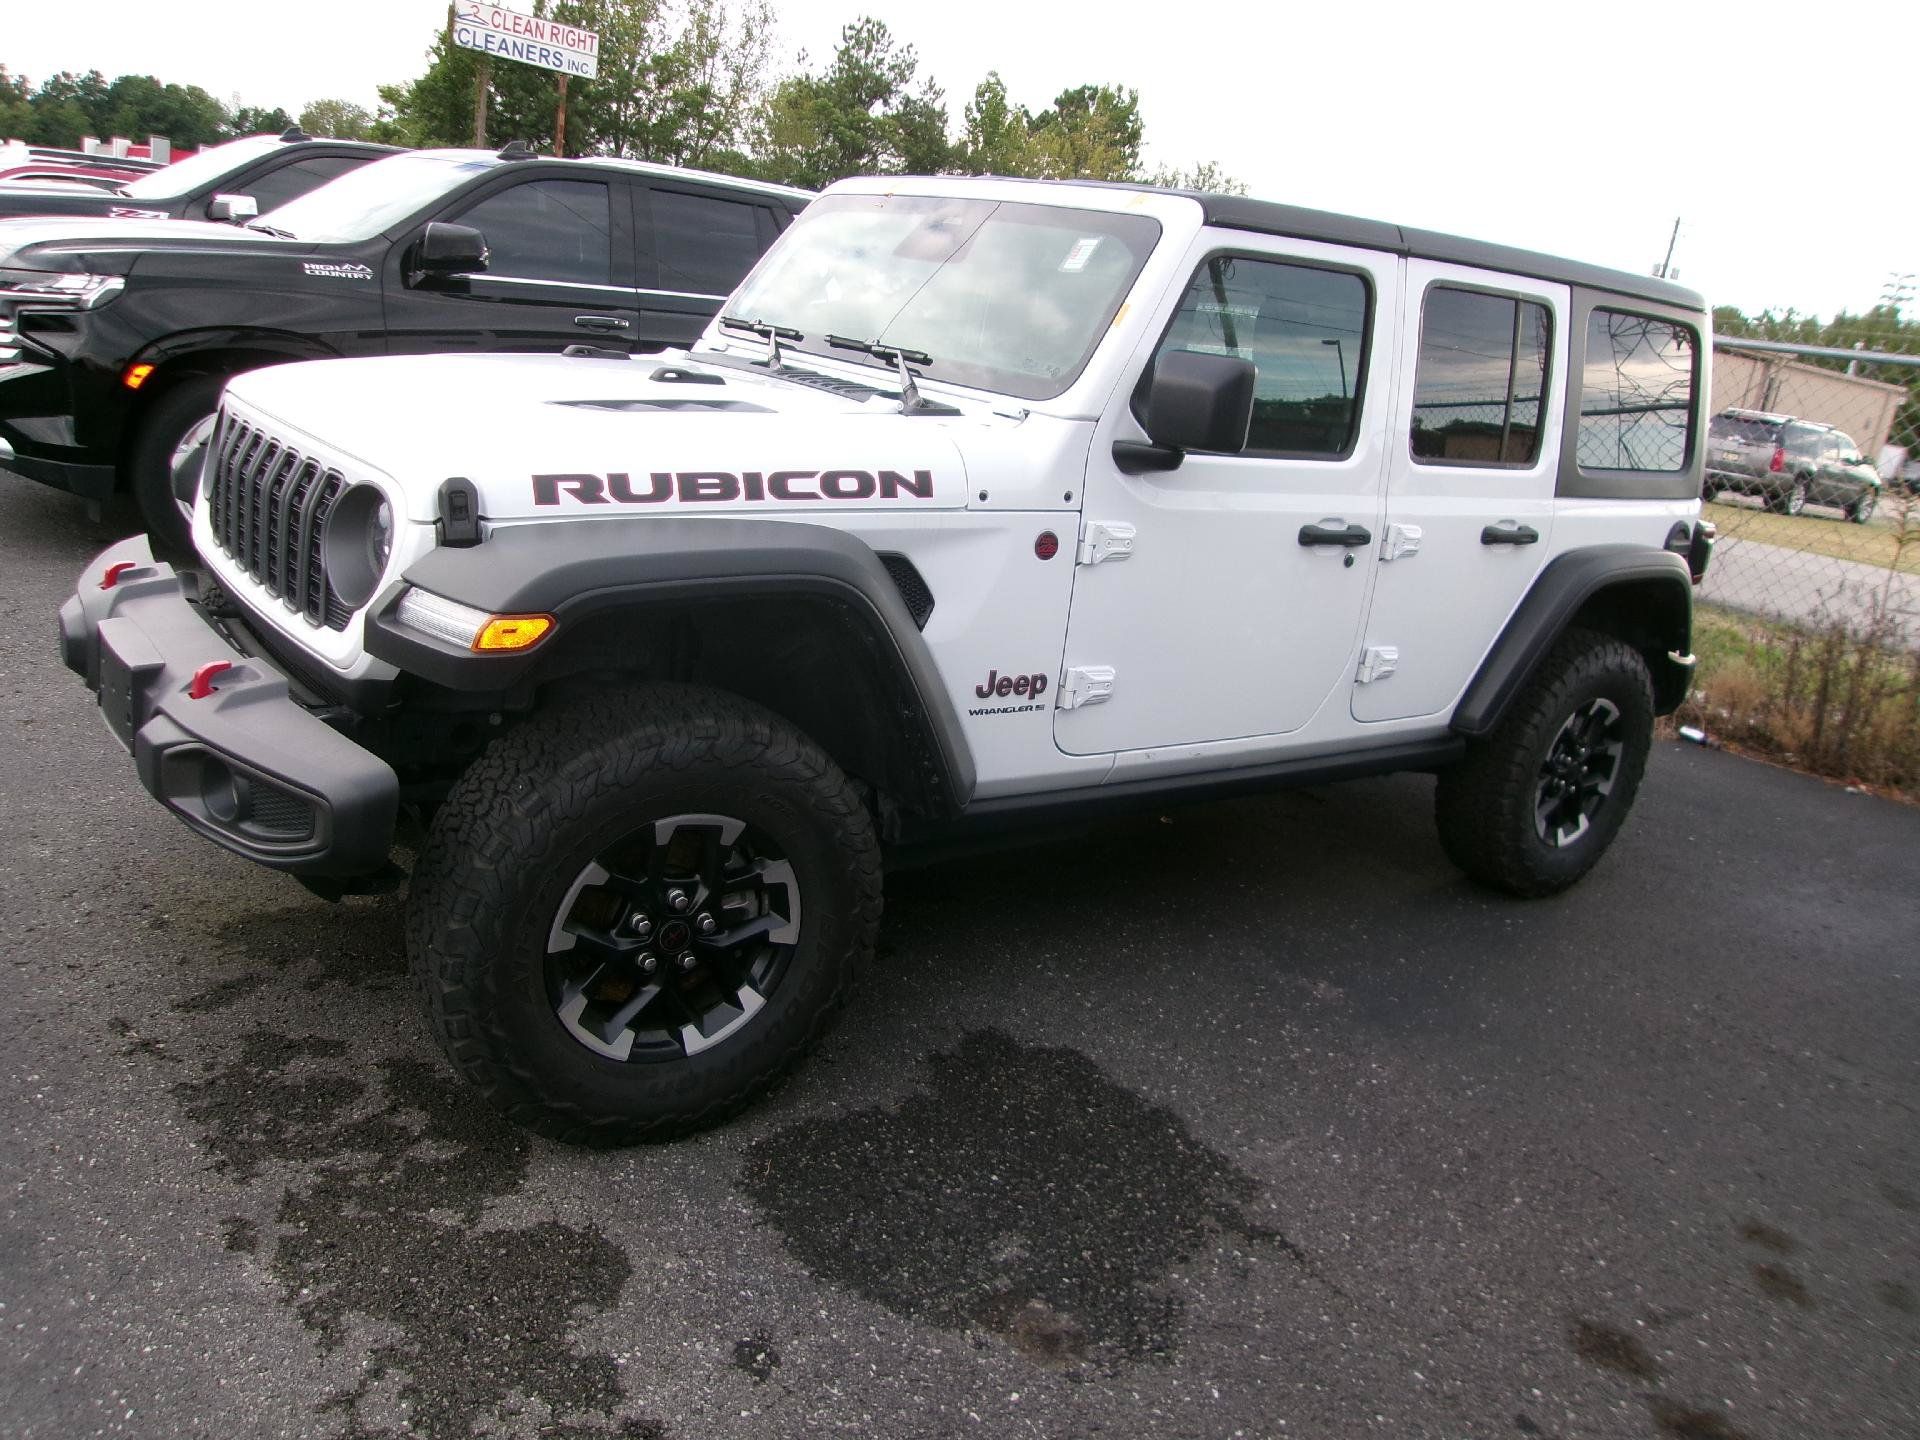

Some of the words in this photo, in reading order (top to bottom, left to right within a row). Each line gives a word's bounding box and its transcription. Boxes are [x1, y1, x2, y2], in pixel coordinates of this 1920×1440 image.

[491, 10, 545, 40] CLEAN
[550, 24, 597, 53] RIGHT
[457, 27, 564, 68] CLEANERS
[567, 58, 593, 76] INC.
[303, 262, 340, 271] HIGH
[304, 269, 374, 280] COUNTRY
[531, 470, 934, 506] RUBICON
[975, 669, 1048, 700] Jeep
[968, 704, 1034, 716] WRANGLER
